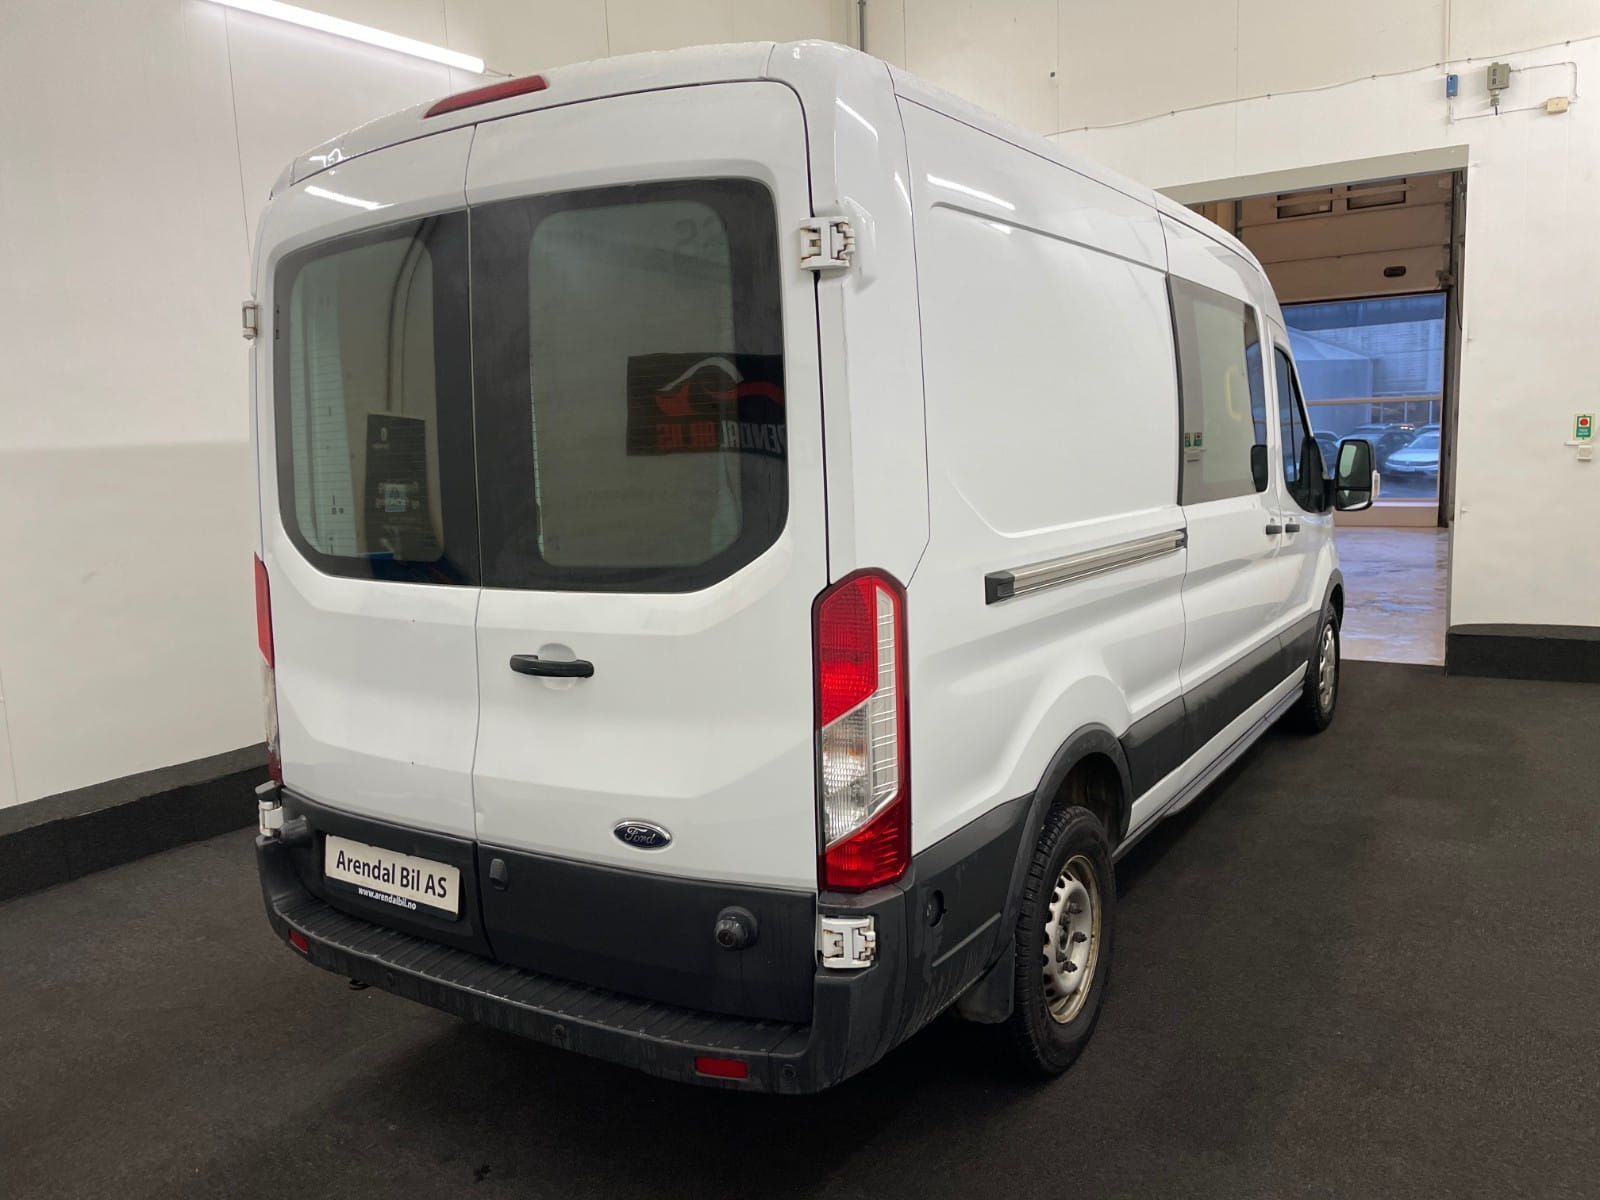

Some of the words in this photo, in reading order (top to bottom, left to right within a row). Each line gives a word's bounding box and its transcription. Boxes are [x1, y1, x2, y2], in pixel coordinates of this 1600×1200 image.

[624, 826, 656, 844] Ford
[336, 850, 395, 885] Arendal
[400, 866, 420, 891] Bil
[424, 874, 447, 898] AS
[358, 887, 417, 910] www.arendalbil.no
